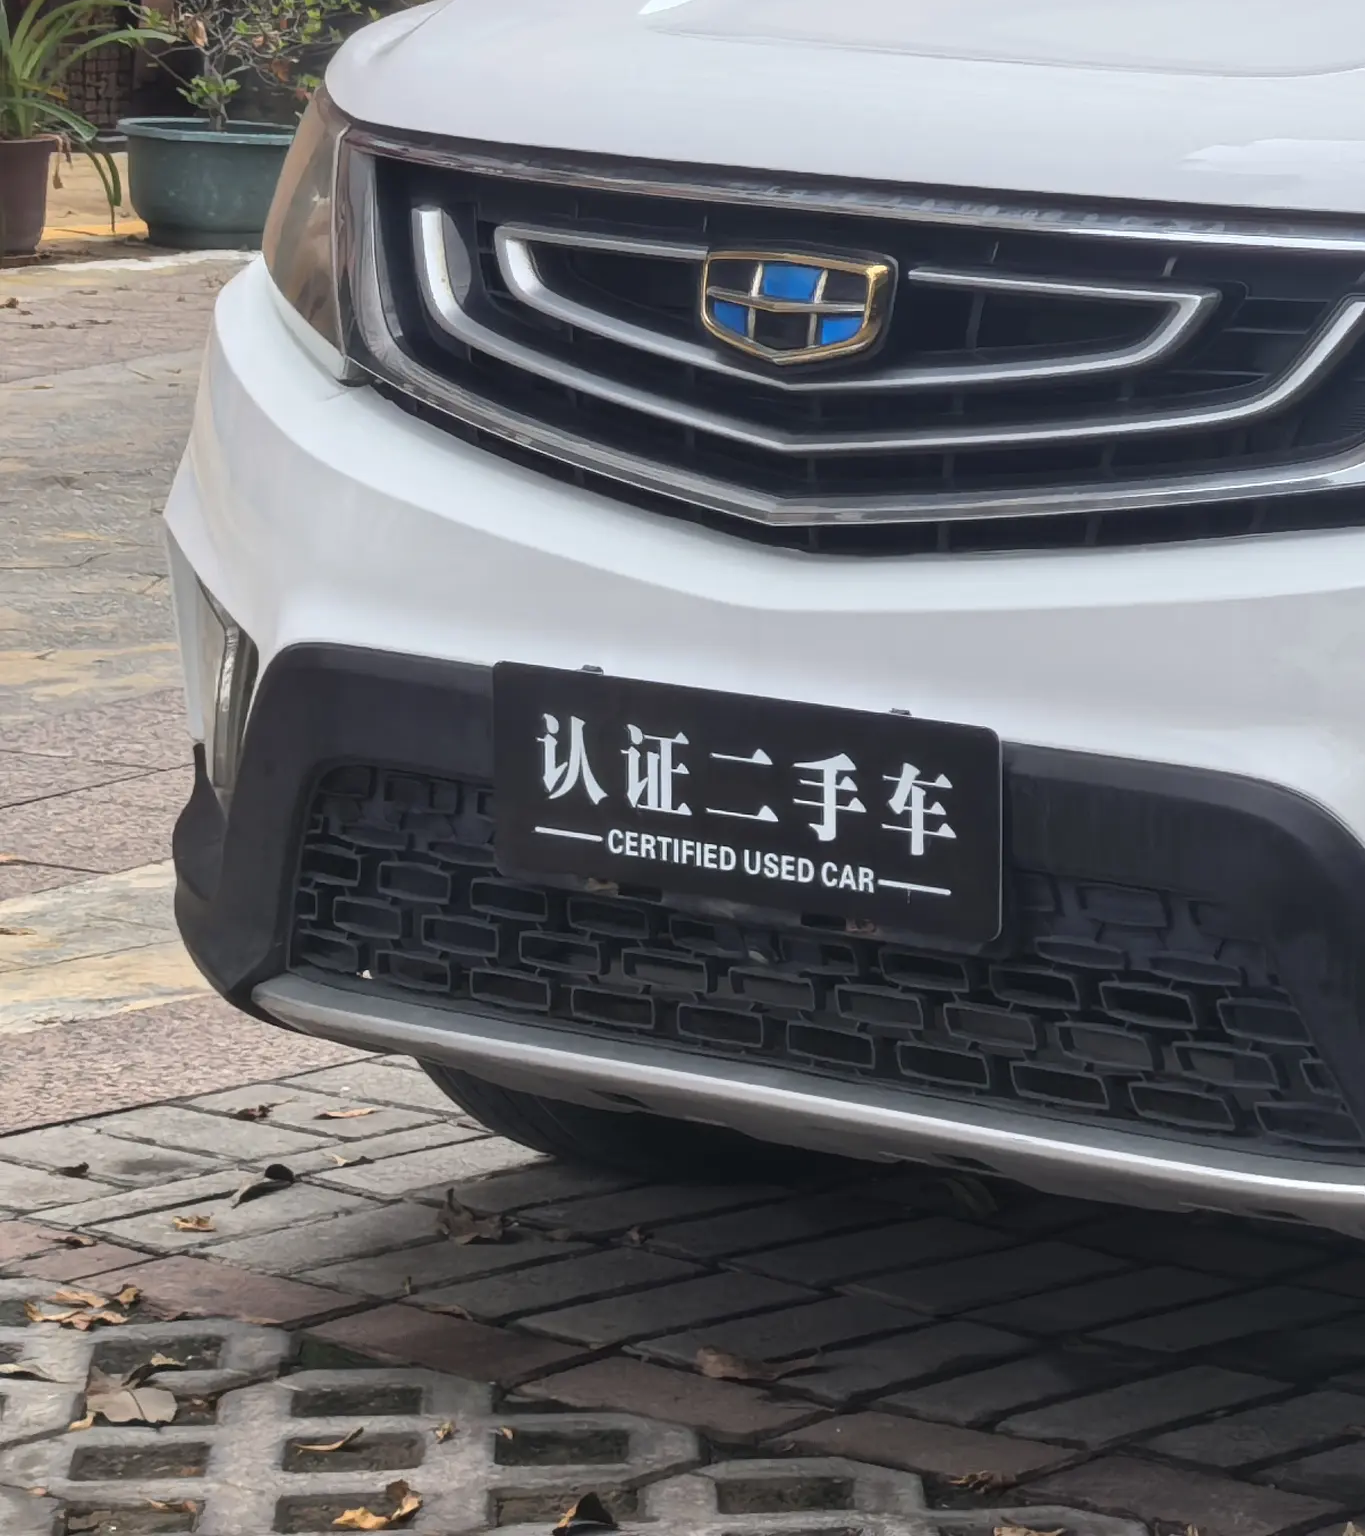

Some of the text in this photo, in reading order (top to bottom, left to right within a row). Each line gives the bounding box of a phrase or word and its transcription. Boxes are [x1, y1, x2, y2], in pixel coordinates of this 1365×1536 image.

[536, 713, 957, 856] 认证二手车
[608, 828, 875, 894] CERTIFIED USED CAR
